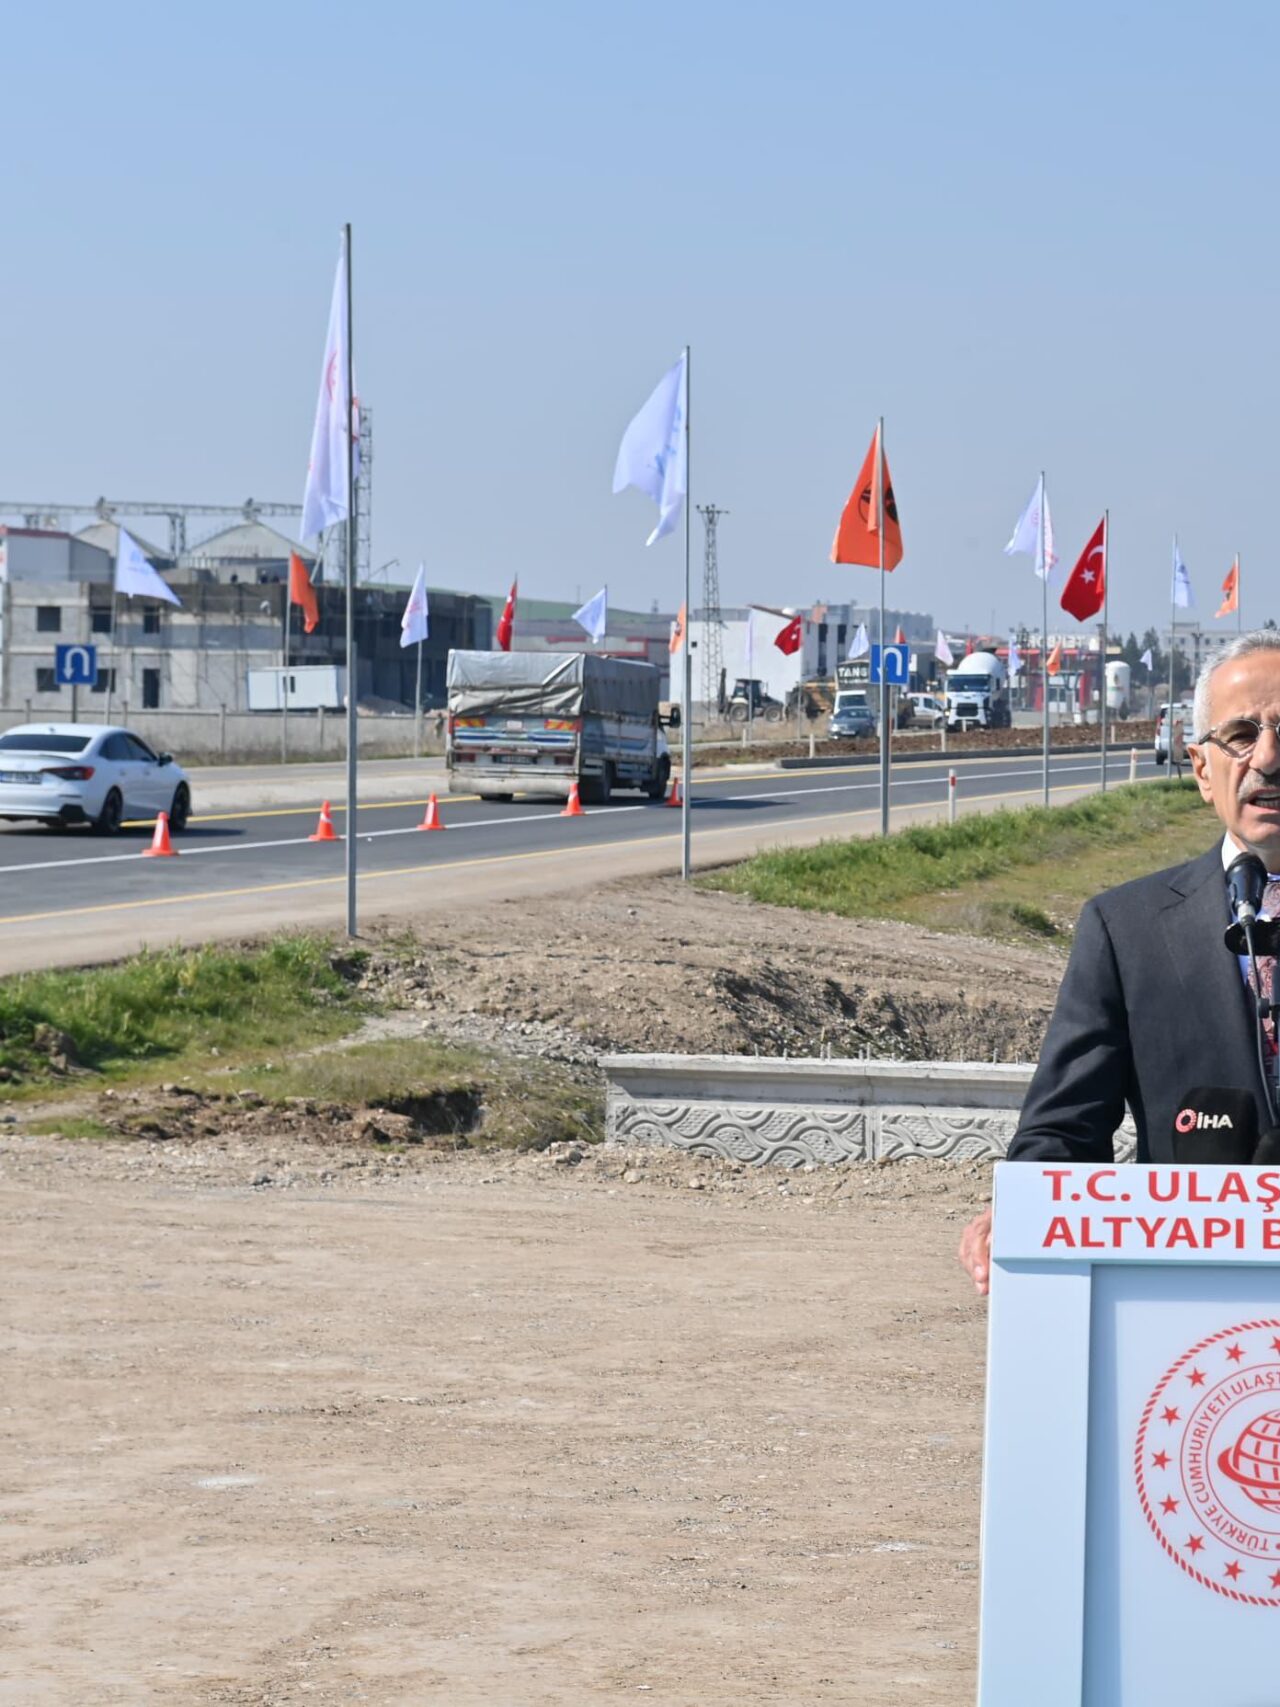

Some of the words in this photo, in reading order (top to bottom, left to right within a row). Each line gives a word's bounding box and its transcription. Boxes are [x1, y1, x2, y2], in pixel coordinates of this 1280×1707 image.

[1043, 1169, 1132, 1202] T.C.
[1043, 1216, 1246, 1249] ALTYAPI
[1189, 1390, 1232, 1504] CUMHURİYETİ
[1204, 1504, 1269, 1552] TÜRKİYE
